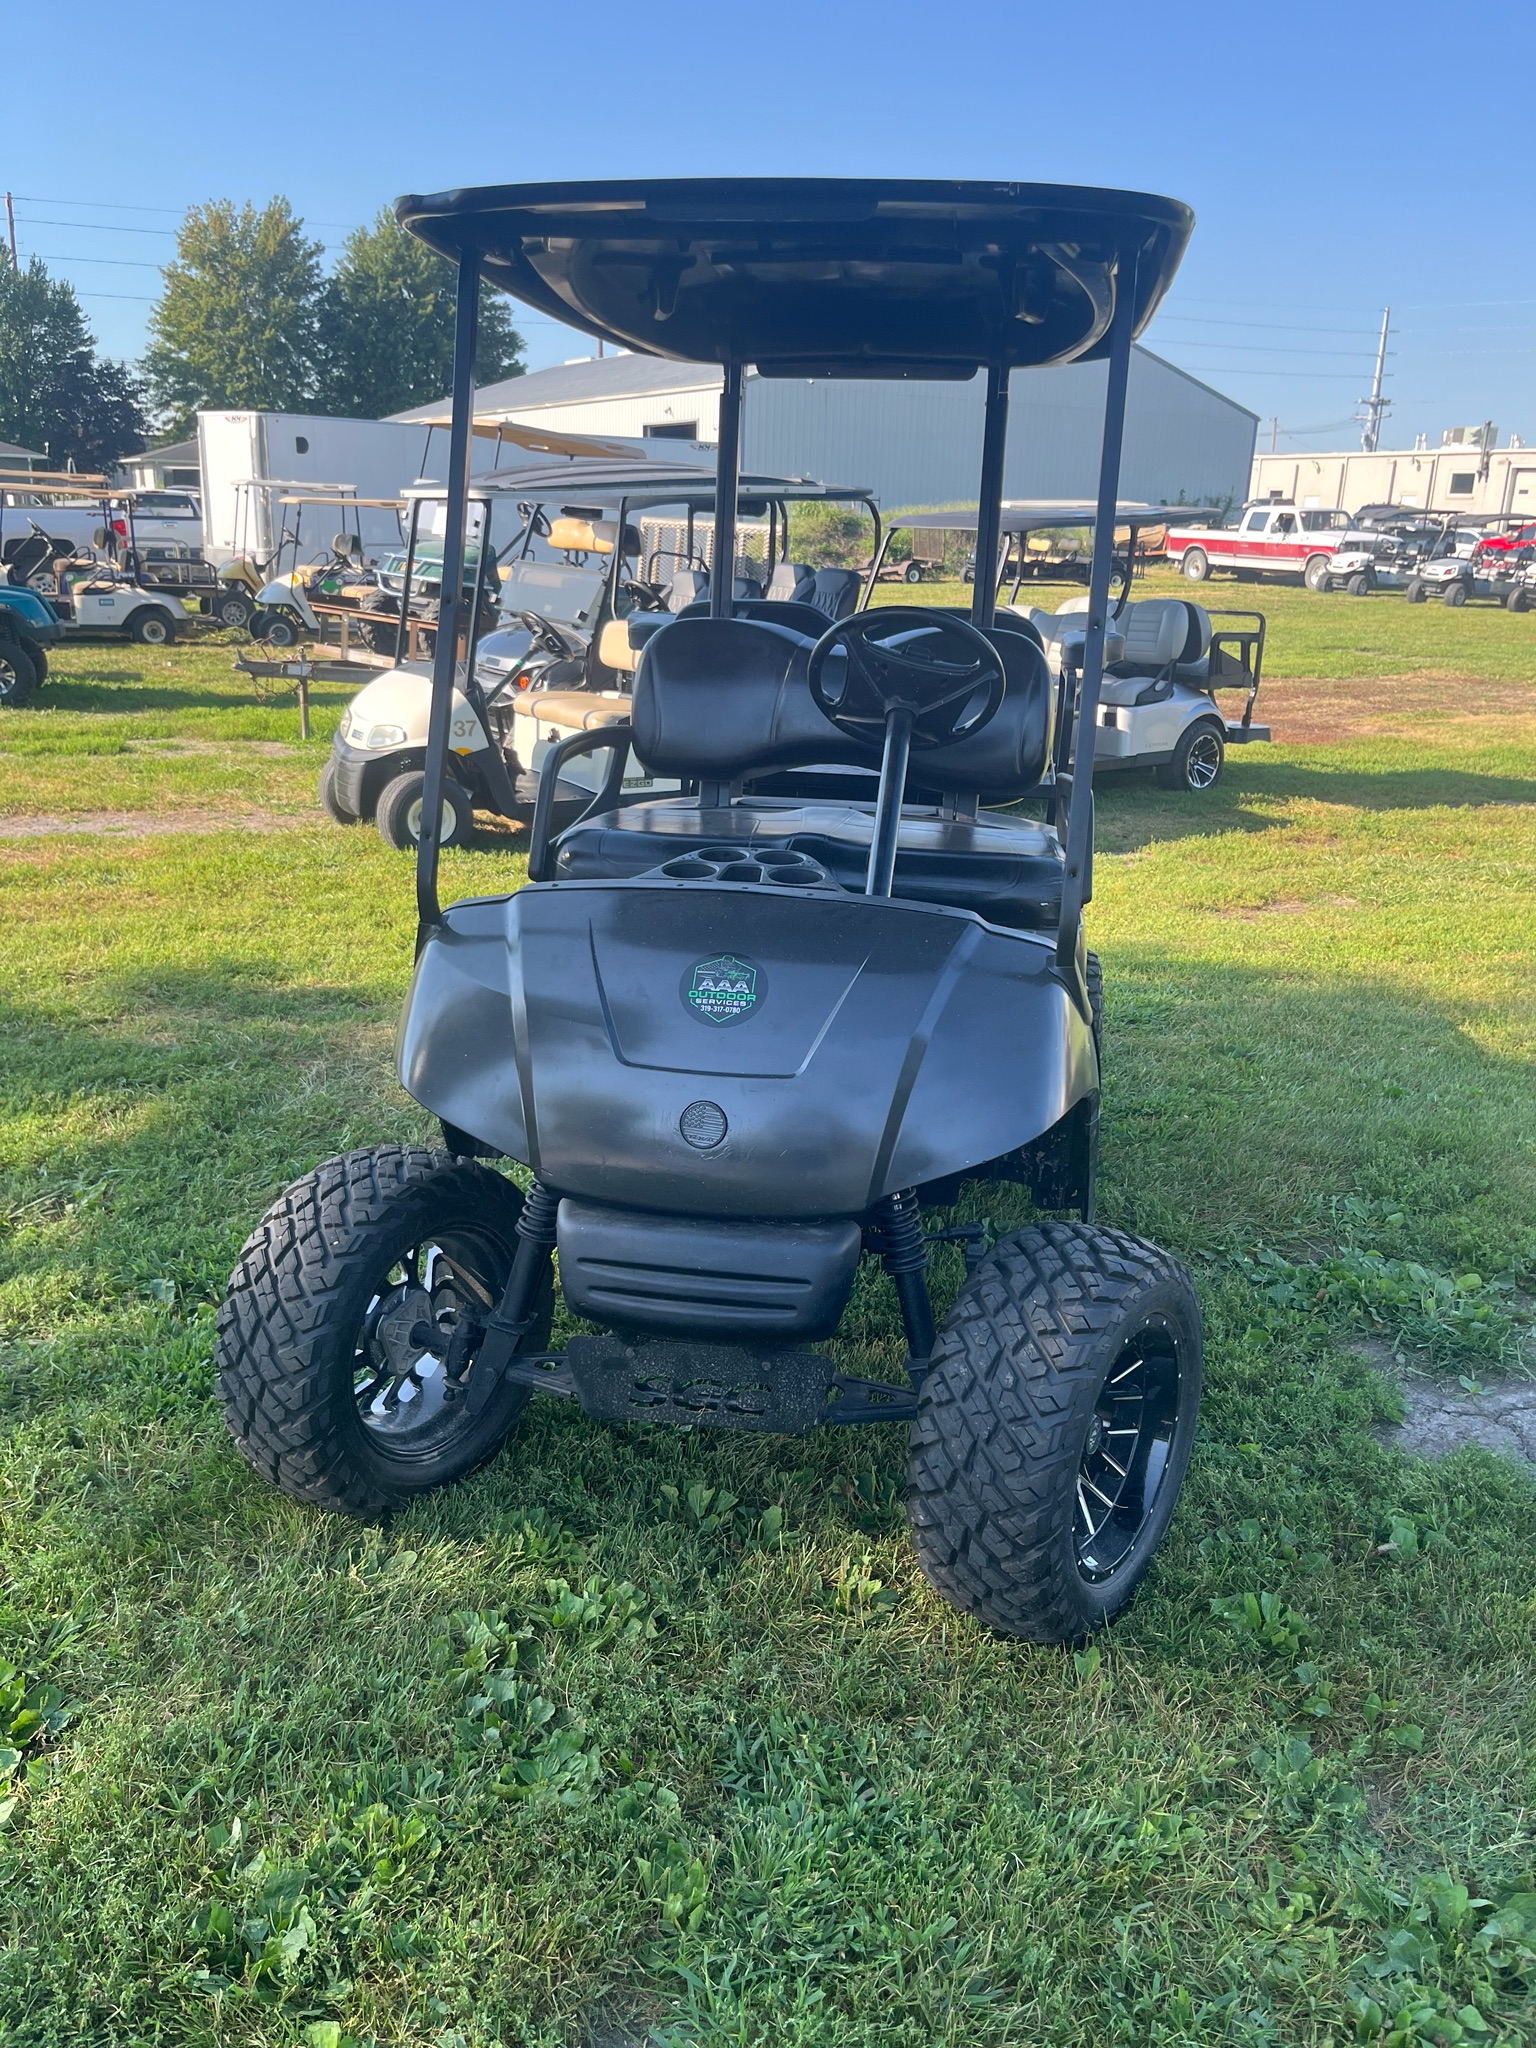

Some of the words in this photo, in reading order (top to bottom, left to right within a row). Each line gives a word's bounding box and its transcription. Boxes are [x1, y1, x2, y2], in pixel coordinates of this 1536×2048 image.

[453, 720, 477, 737] 37
[698, 978, 750, 993] AAA
[688, 990, 756, 1001] OUTDOOR
[695, 998, 747, 1007] SERVICES
